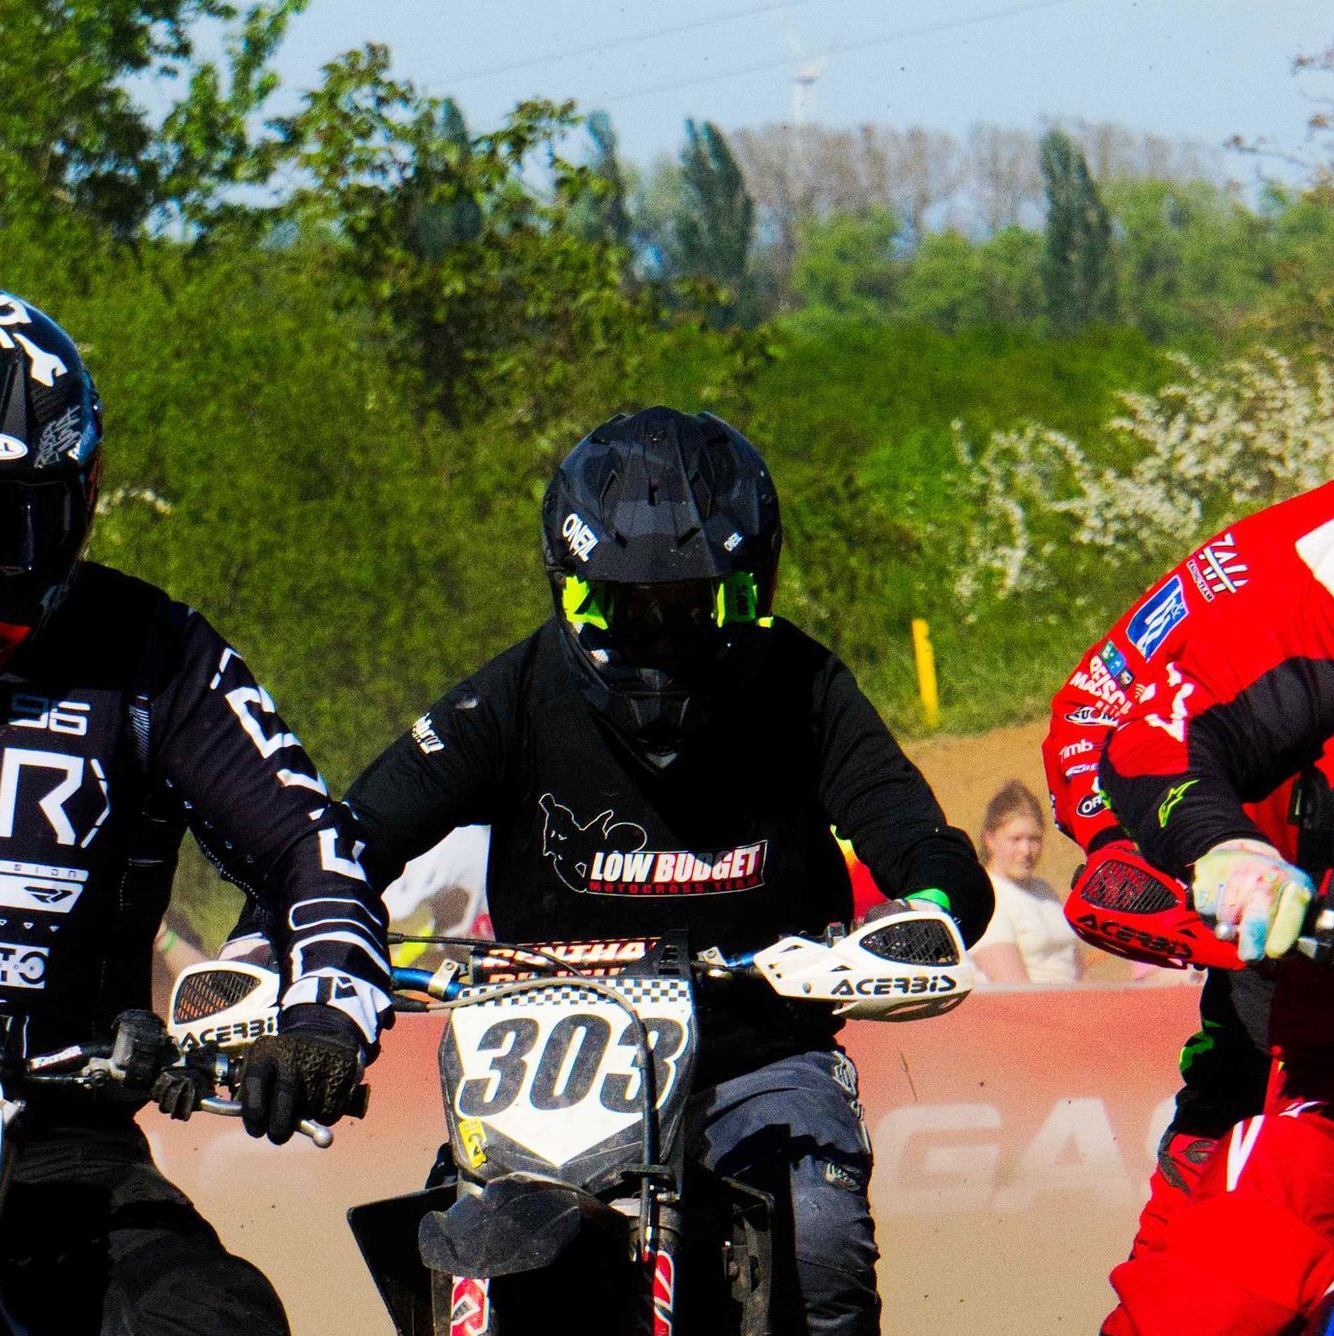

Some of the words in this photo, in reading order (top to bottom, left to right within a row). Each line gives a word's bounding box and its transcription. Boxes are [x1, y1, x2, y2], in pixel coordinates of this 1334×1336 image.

[589, 852, 655, 884] LOW
[653, 846, 761, 883] BUDGET
[588, 880, 705, 895] MOTOCROSS
[714, 876, 759, 892] TEAM
[831, 976, 958, 996] ACERBIS
[180, 1021, 275, 1050] ACERBI
[459, 1013, 683, 1117] 303
